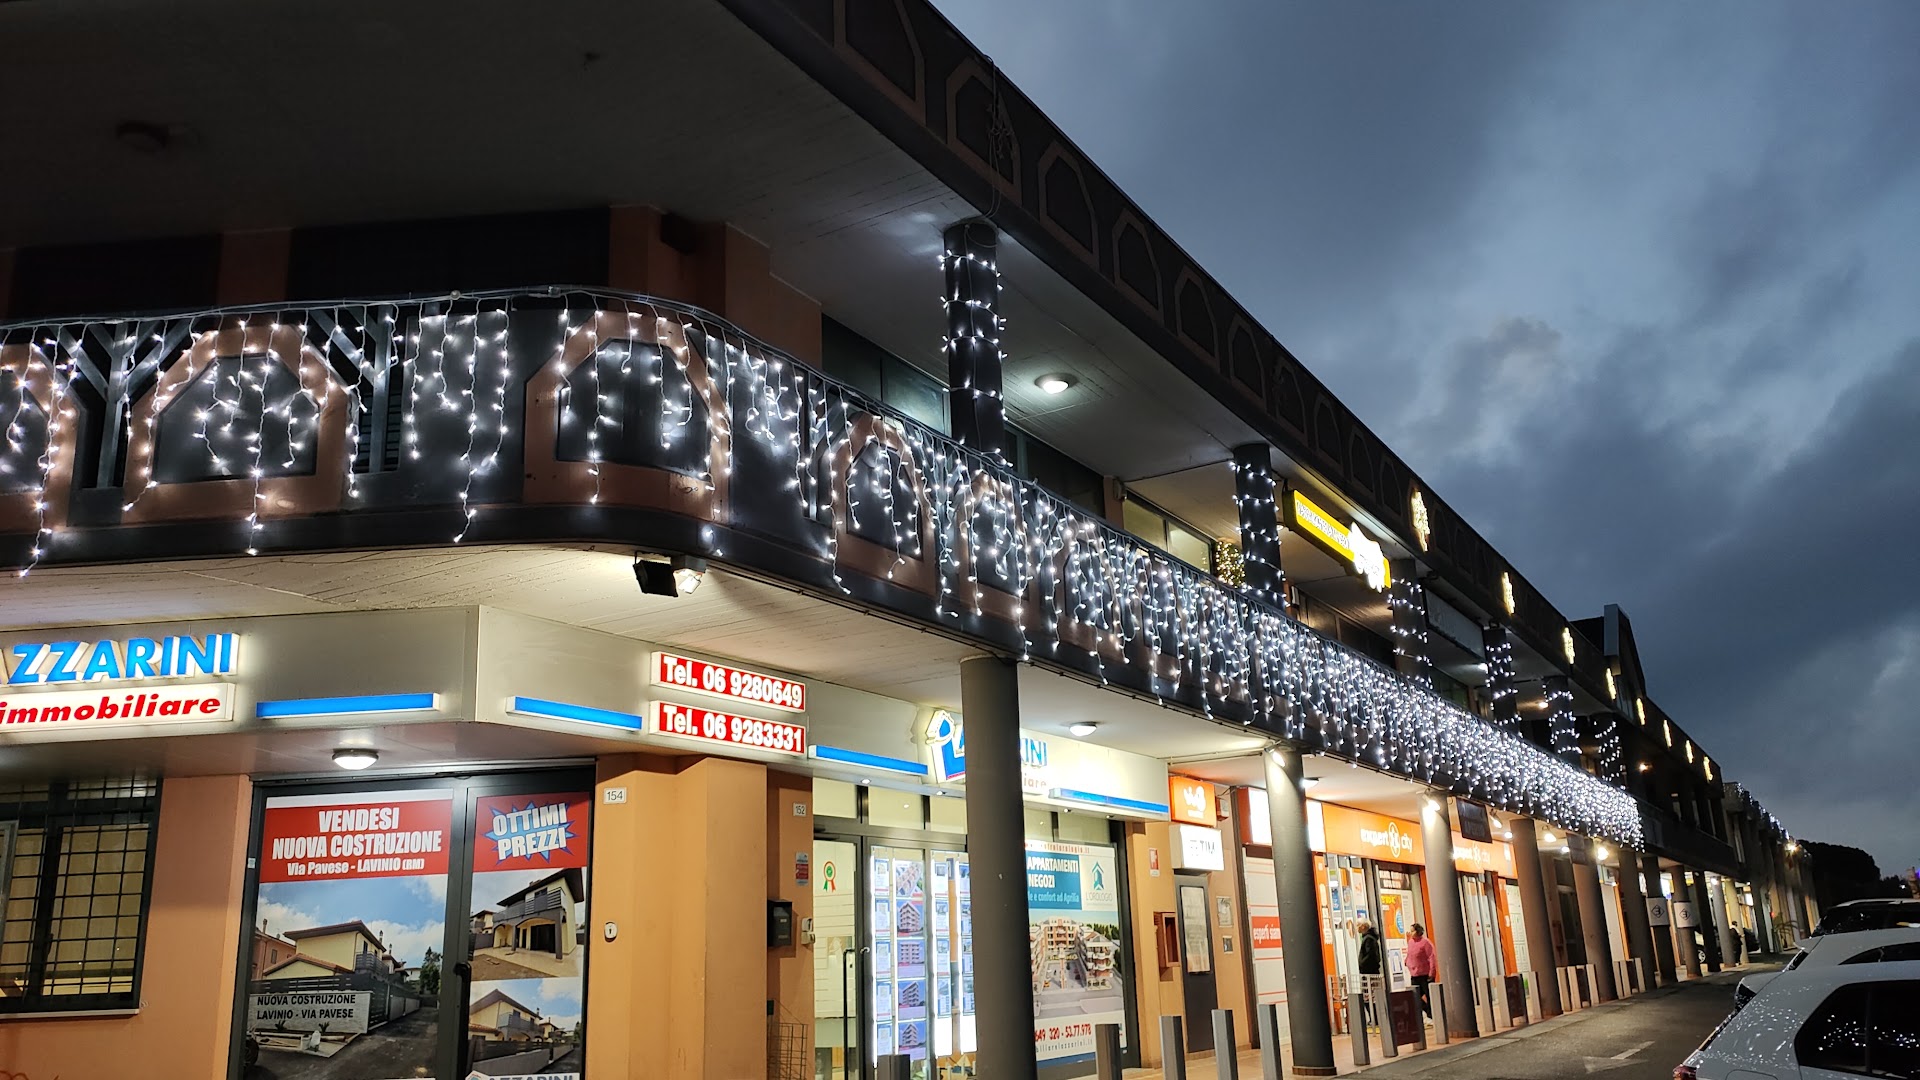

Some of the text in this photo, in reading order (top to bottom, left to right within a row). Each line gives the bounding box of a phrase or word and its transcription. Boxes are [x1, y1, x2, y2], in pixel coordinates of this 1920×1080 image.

[0, 633, 233, 684] ZZARINI
[663, 655, 802, 708] Tel. 06 9280649
[0, 693, 221, 725] immobiliare
[663, 704, 802, 752] Tel. 06 9283331
[607, 790, 624, 801] 154
[318, 807, 400, 833] VENDESI
[492, 802, 568, 836] OTTIMI
[795, 804, 806, 815] 152
[272, 830, 442, 860] NUOVA COSTRUZIONE
[497, 826, 567, 860] PREZZI
[1360, 828, 1413, 853] expert city
[287, 862, 306, 876] Via
[307, 861, 349, 875] Pavese
[357, 857, 401, 873] LAVINIO
[402, 858, 425, 871] (RM)
[1026, 856, 1079, 873] APPARTAMENTI
[1028, 873, 1056, 889] NEGOZI
[257, 994, 356, 1006] NUOVA COSTRUZIONE
[256, 1009, 294, 1020] LAVINIO
[301, 1009, 317, 1019] VIA
[319, 1008, 354, 1019] PAVESE
